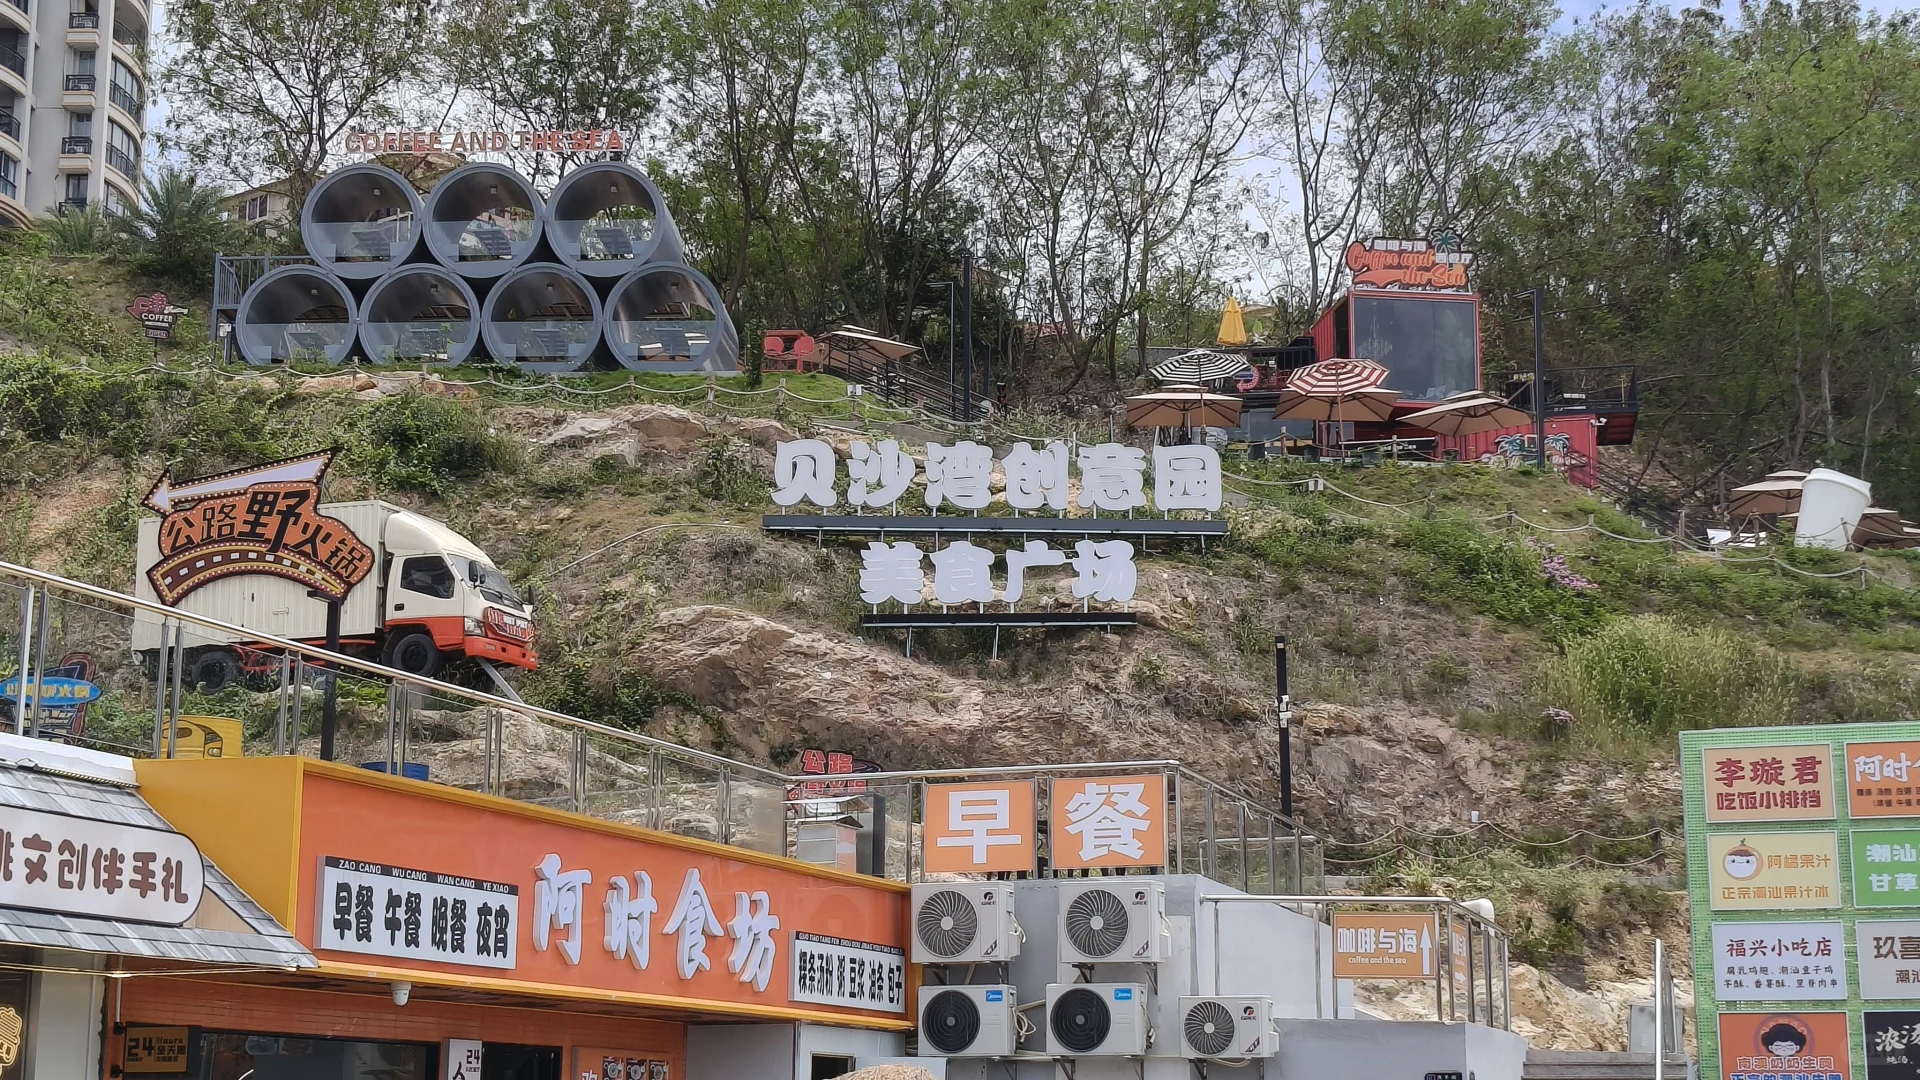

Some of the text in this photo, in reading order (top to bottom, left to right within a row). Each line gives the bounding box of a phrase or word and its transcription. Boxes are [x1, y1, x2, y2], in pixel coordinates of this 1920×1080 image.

[346, 131, 623, 151] COFFEE AND THE SEA
[771, 438, 1223, 512] 贝沙湾创意园
[165, 488, 367, 582] 公路野火锅
[859, 540, 1137, 604] 美食广场
[803, 750, 852, 773] 公路
[1714, 756, 1822, 788] 李璇君
[1853, 752, 1920, 783] 阿时
[1866, 843, 1920, 863] 潮汕
[339, 859, 509, 894] ZAO CANG WU CANG WAN CANG YE XIAO
[333, 881, 510, 959] 早餐 午餐 晚餐 夜宵
[532, 853, 780, 992] 阿时食坊
[1337, 927, 1417, 954] 咖啡与海
[1726, 937, 1832, 957] 福兴小吃店
[848, 956, 866, 1001] 豆浆
[868, 959, 884, 1003] 油条
[887, 961, 903, 1006] 包子
[128, 1037, 154, 1057] 24
[157, 1045, 187, 1056] 全天
[466, 1049, 480, 1064] 24
